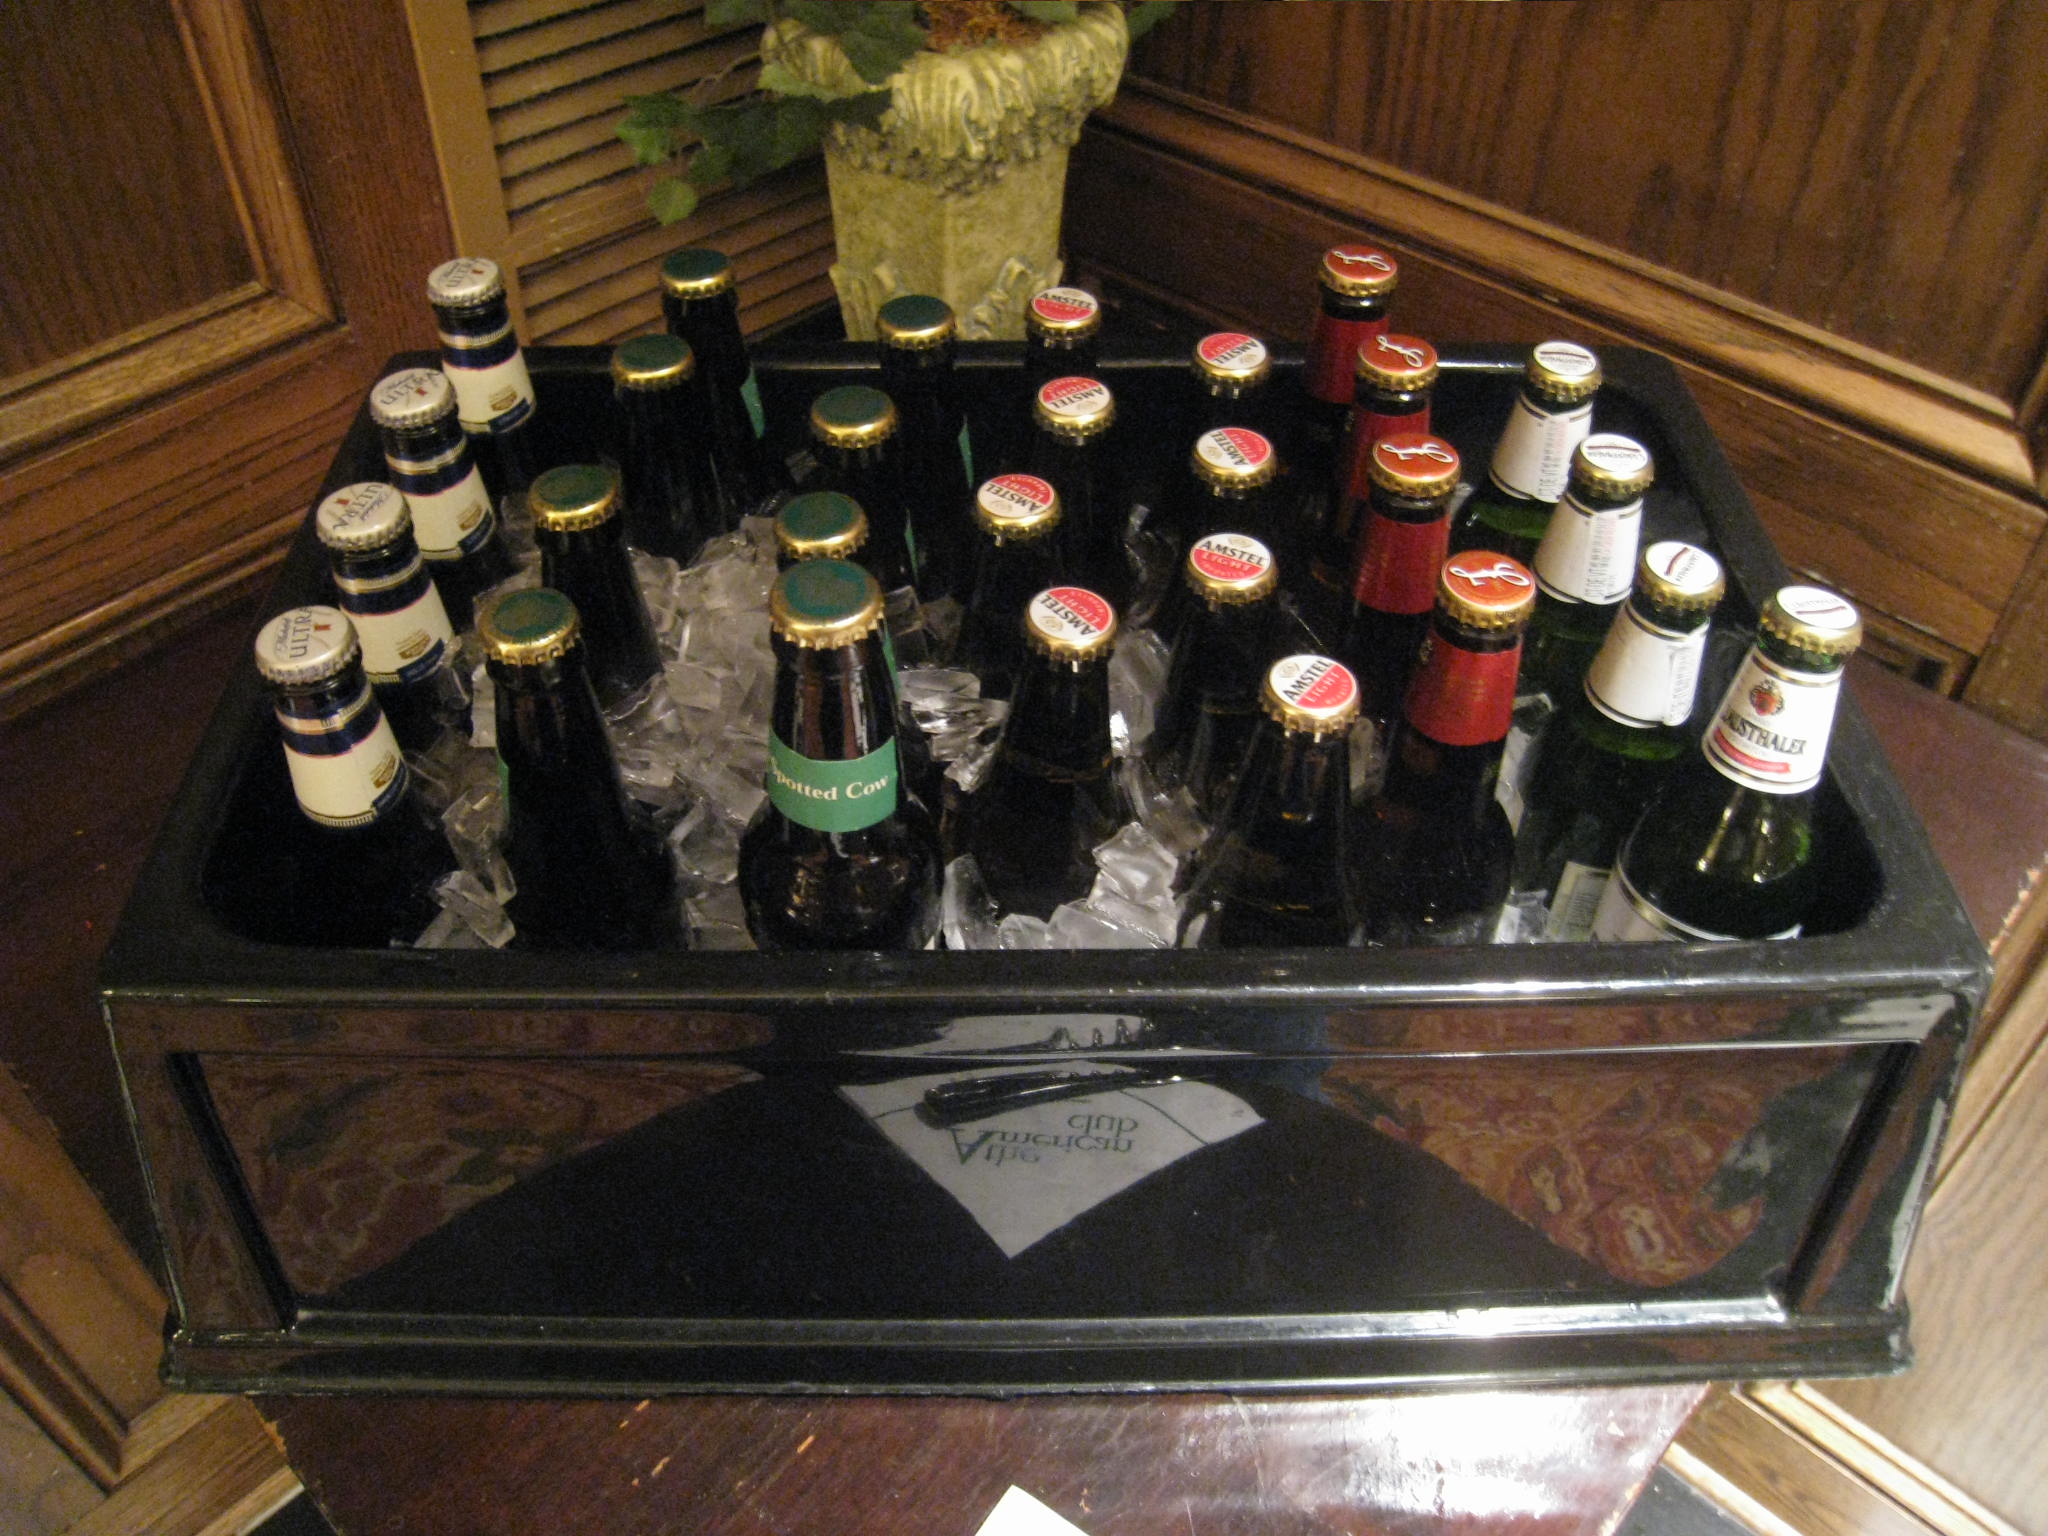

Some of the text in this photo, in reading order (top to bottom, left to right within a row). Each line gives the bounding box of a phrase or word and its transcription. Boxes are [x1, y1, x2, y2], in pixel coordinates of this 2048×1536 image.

[1039, 291, 1093, 310] AMSTEL
[1212, 340, 1259, 364] AMSTEL
[1050, 386, 1106, 409] AMSTEL
[1211, 430, 1249, 466] AMSTEL
[985, 483, 1043, 512] AMSTEL
[1199, 540, 1265, 567] AMSTEL
[1202, 551, 1252, 572] LIGHT
[1039, 594, 1097, 636] AMSTEL
[1283, 658, 1333, 702] AMSTEL
[1303, 672, 1342, 703] LIGHT
[845, 775, 889, 799] Cow
